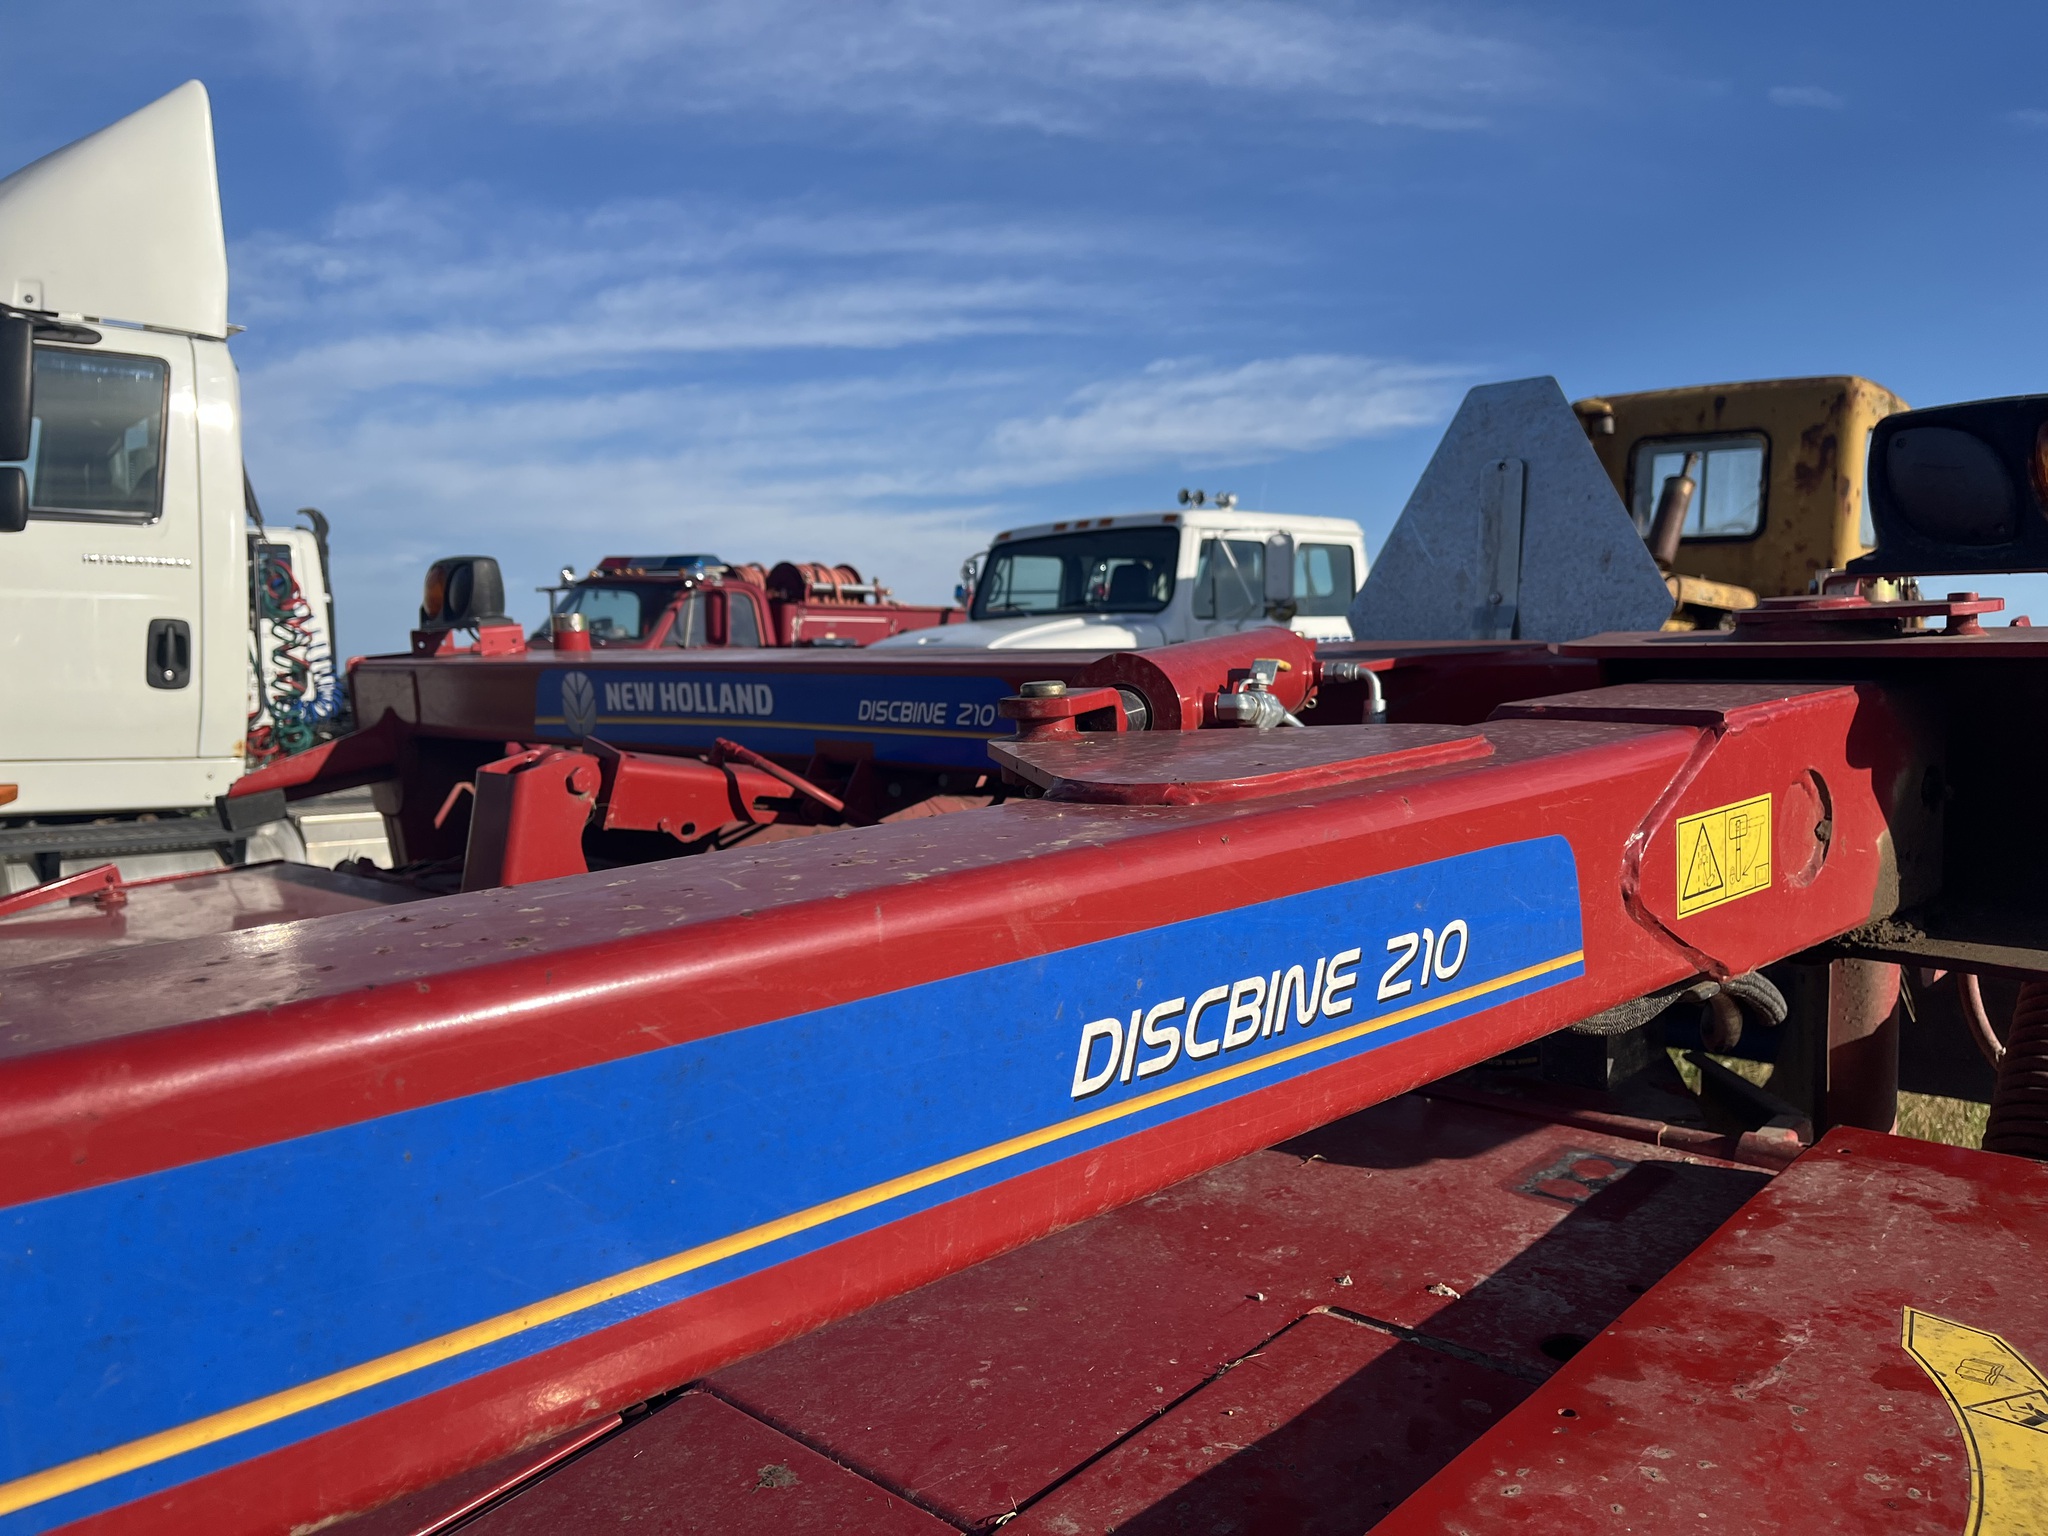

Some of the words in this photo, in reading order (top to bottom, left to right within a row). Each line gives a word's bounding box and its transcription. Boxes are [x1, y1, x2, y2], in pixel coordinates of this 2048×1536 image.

[605, 682, 654, 712] NEW
[659, 682, 773, 717] HOLLAND
[858, 700, 947, 725] DISCBINE
[955, 703, 996, 727] 210
[1070, 947, 1362, 1099] DISCBINE
[1376, 919, 1469, 1002] 210
